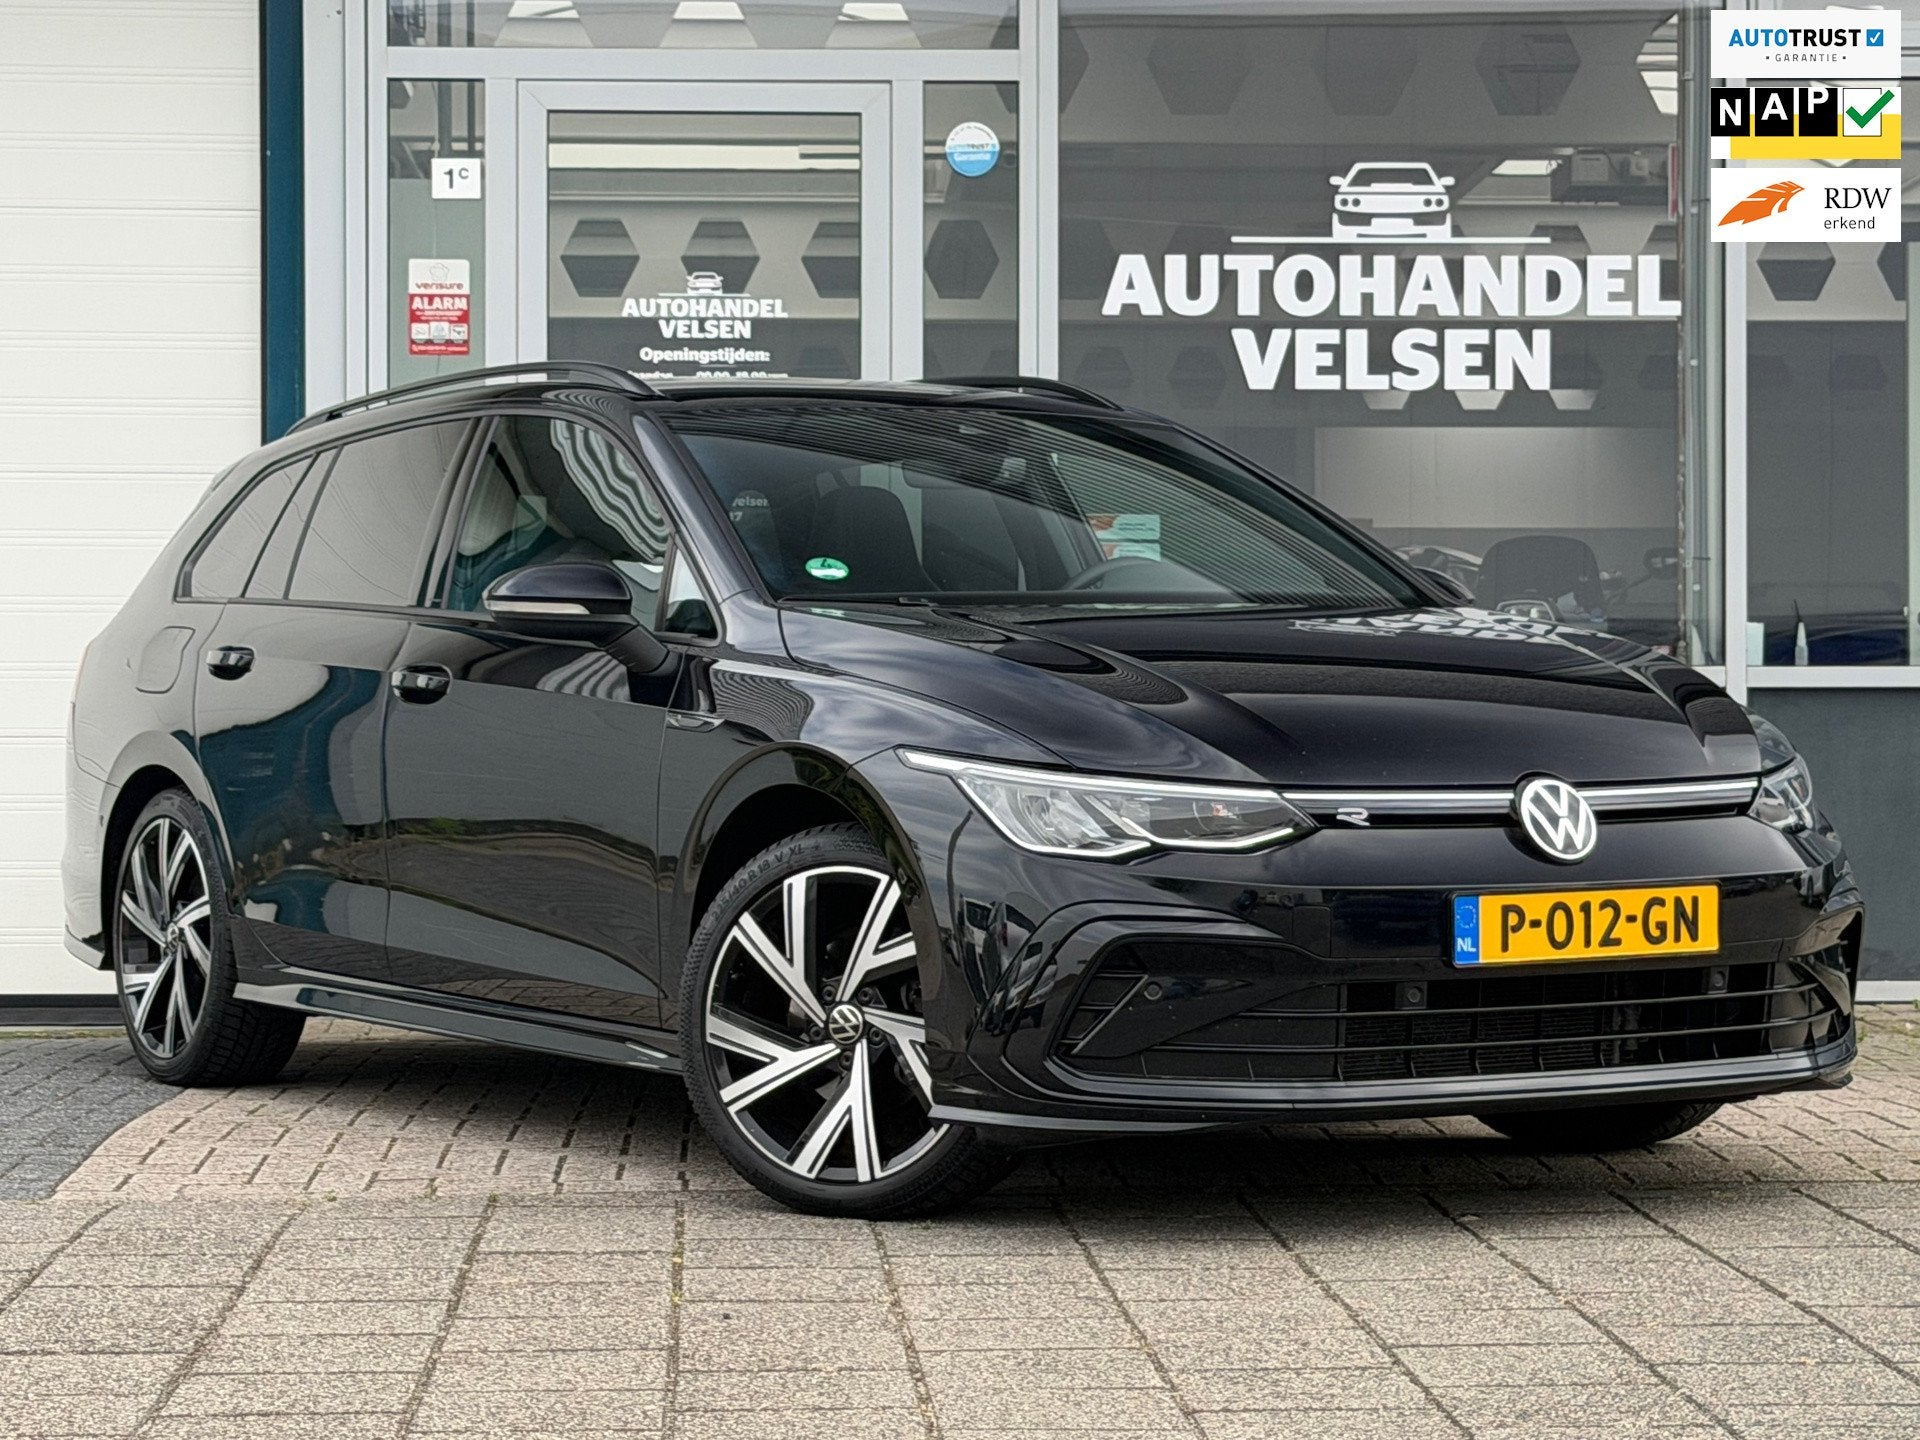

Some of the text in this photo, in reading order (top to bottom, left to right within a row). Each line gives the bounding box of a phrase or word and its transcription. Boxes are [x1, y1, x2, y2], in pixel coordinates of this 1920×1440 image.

[415, 282, 464, 291] verisure
[1101, 253, 1682, 317] AUTOHANDEL
[411, 296, 468, 311] ALARM
[621, 298, 789, 319] AUTOHANDEL
[658, 319, 752, 339] VELSEN
[639, 346, 771, 364] Openingstijden:
[1230, 327, 1552, 391] VELSEN
[1501, 895, 1700, 953] P-012-GN
[1457, 937, 1477, 952] NL
